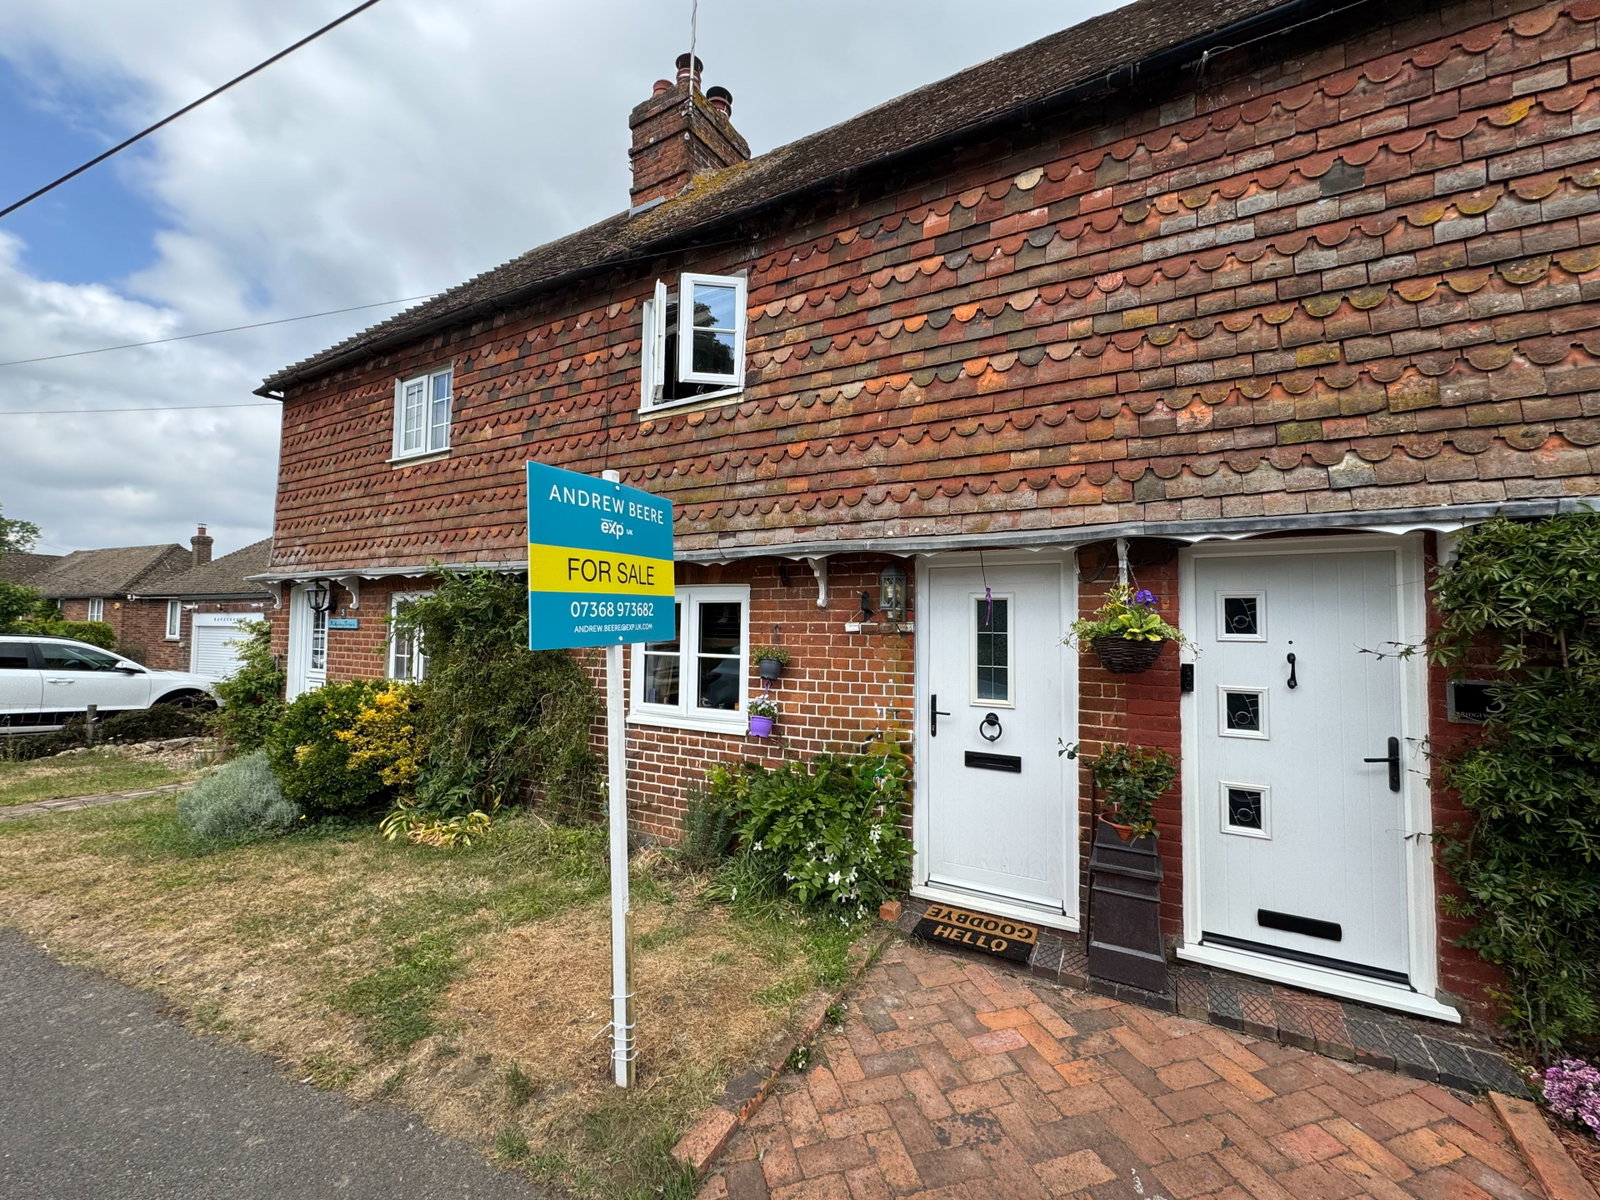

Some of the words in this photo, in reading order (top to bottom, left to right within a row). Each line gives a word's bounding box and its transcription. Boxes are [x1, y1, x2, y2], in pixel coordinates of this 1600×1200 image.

[549, 485, 624, 514] ANDREW
[628, 502, 664, 525] BEERE
[568, 557, 611, 583] FOR
[617, 562, 655, 586] SALE
[570, 601, 615, 617] 07368
[617, 602, 654, 617] 973682
[926, 906, 1033, 939] GOODBYE
[933, 925, 1008, 952] HELLO
